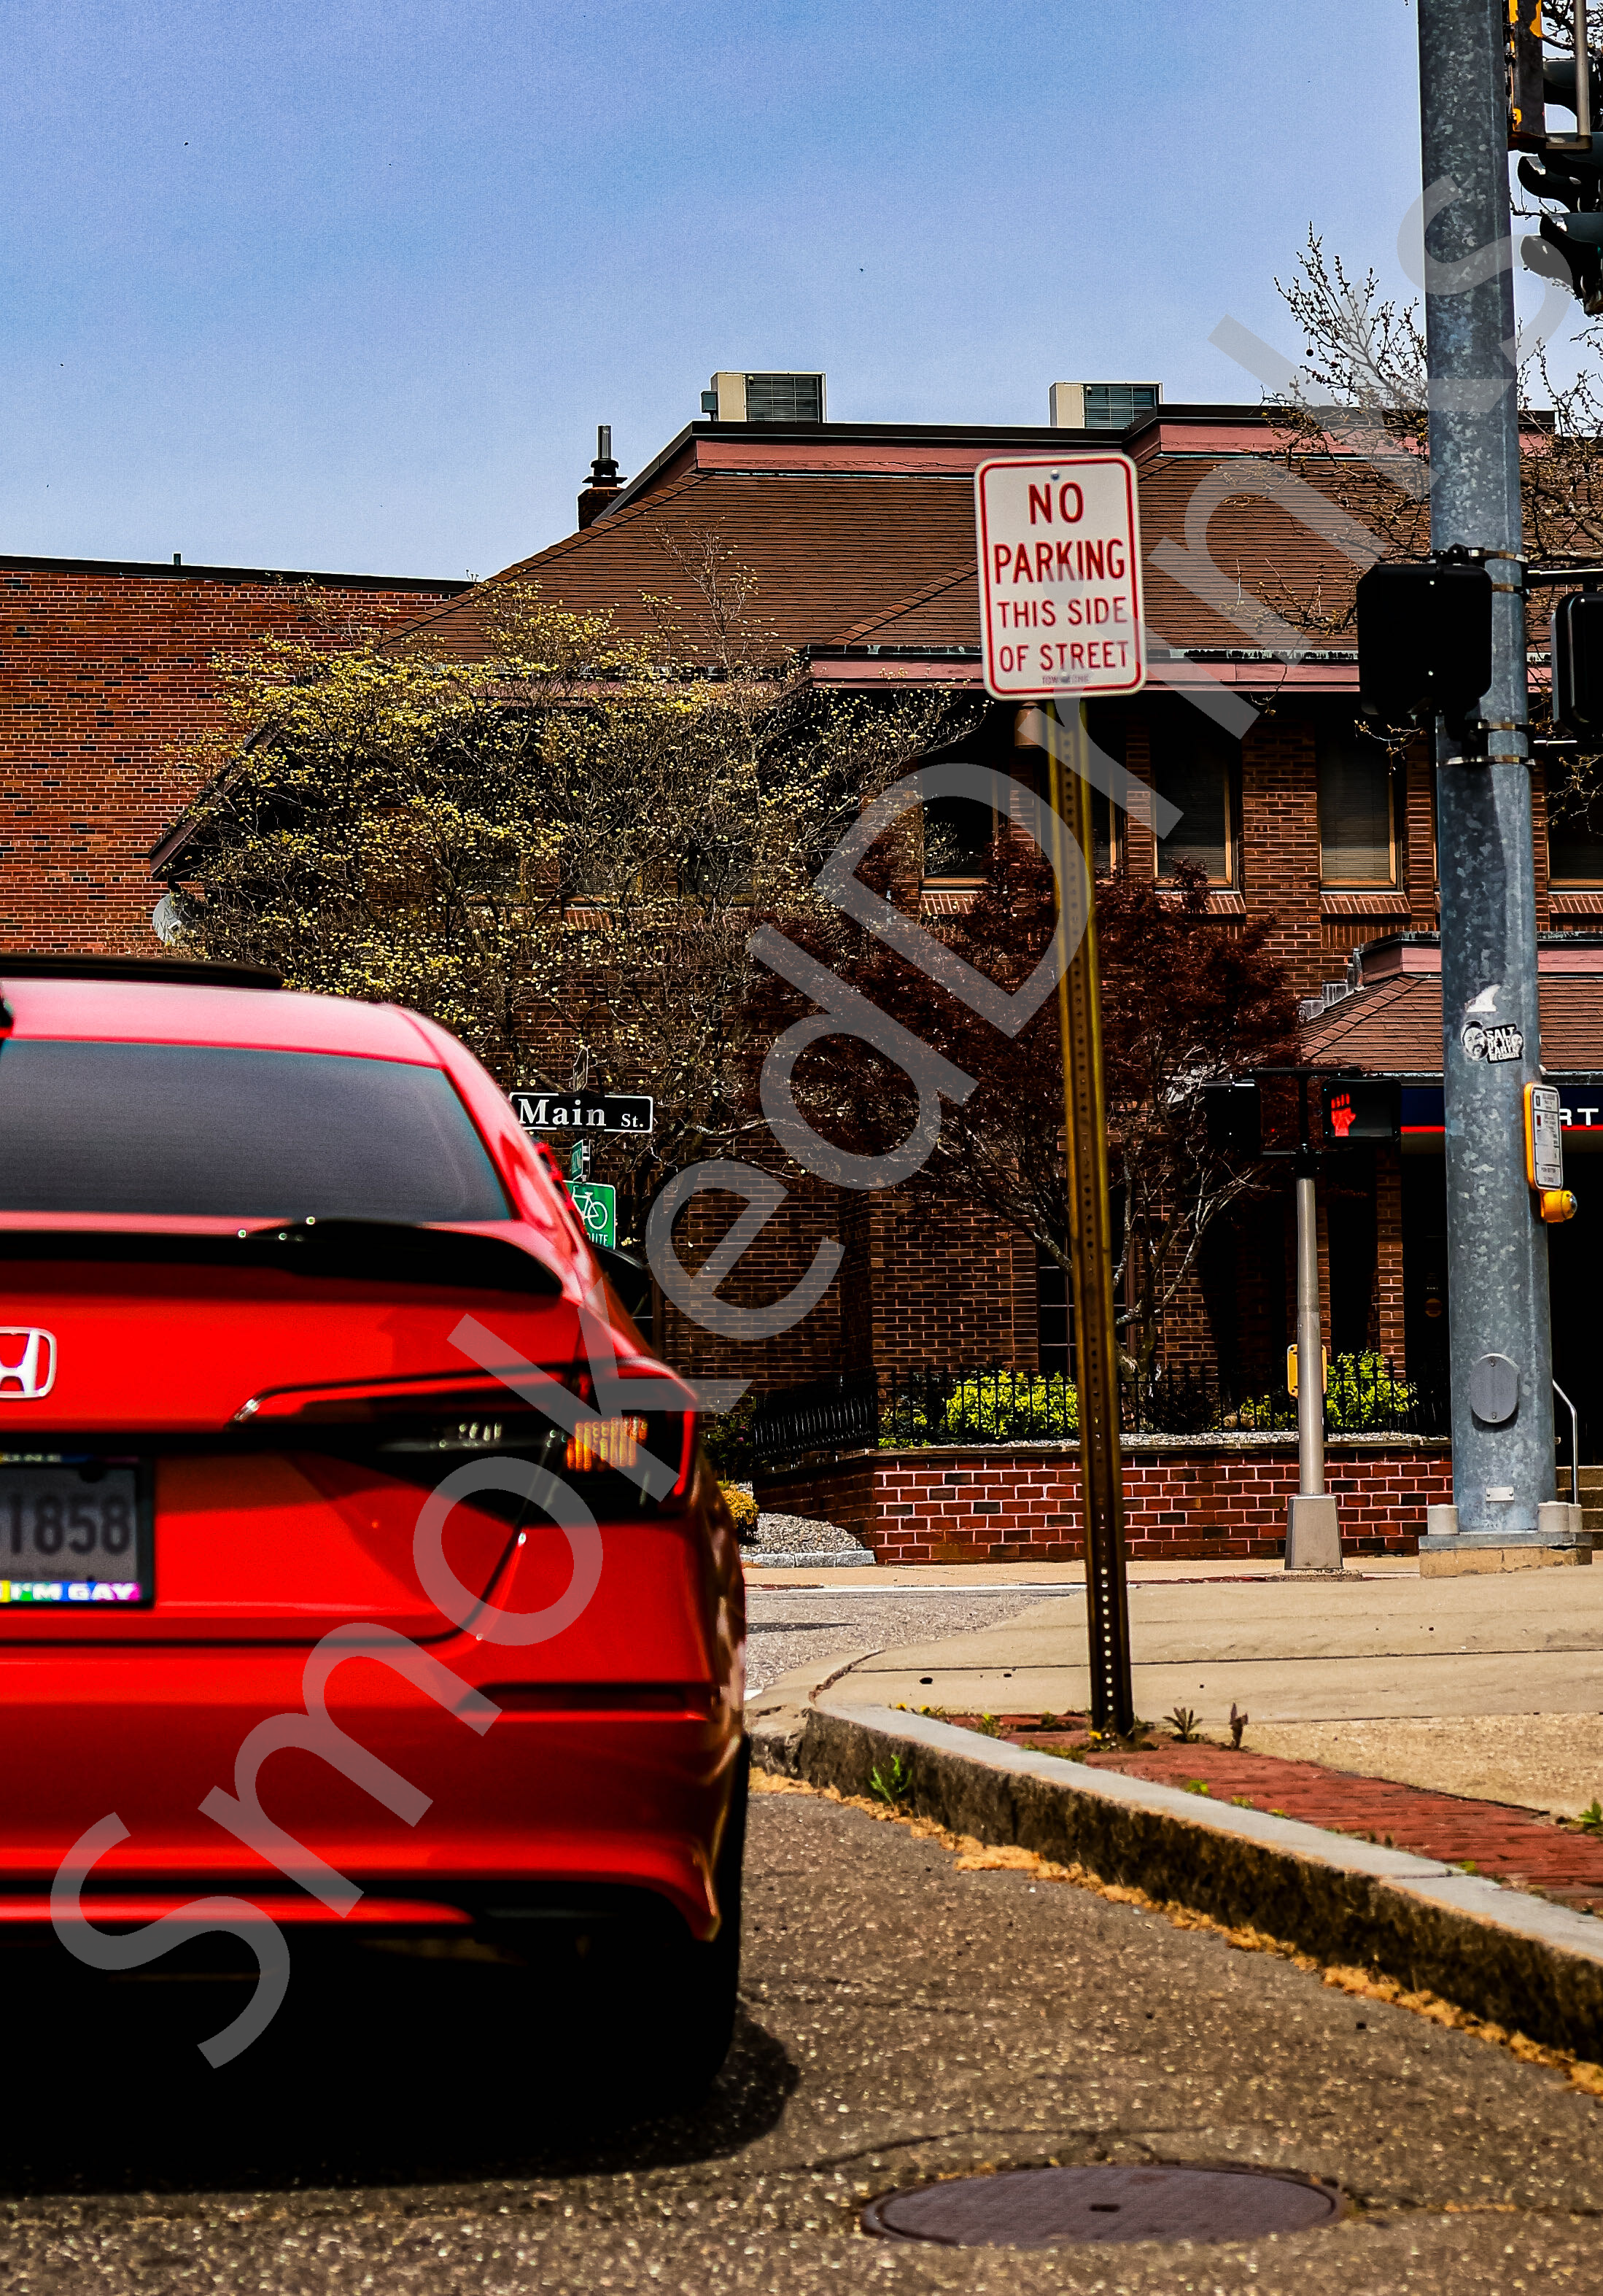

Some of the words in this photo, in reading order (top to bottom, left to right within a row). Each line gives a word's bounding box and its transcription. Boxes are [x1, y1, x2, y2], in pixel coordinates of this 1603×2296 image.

[1028, 481, 1084, 524] NO
[994, 539, 1125, 583] PARKING
[996, 599, 1057, 628] THIS
[1068, 597, 1128, 625] SIDE
[999, 645, 1028, 672] OF
[1039, 640, 1129, 671] STREET
[1486, 1027, 1515, 1042] SALT
[518, 1098, 607, 1127] Main
[621, 1114, 644, 1128] St.
[10, 1495, 131, 1554] 1858
[68, 1583, 134, 1601] GAY
